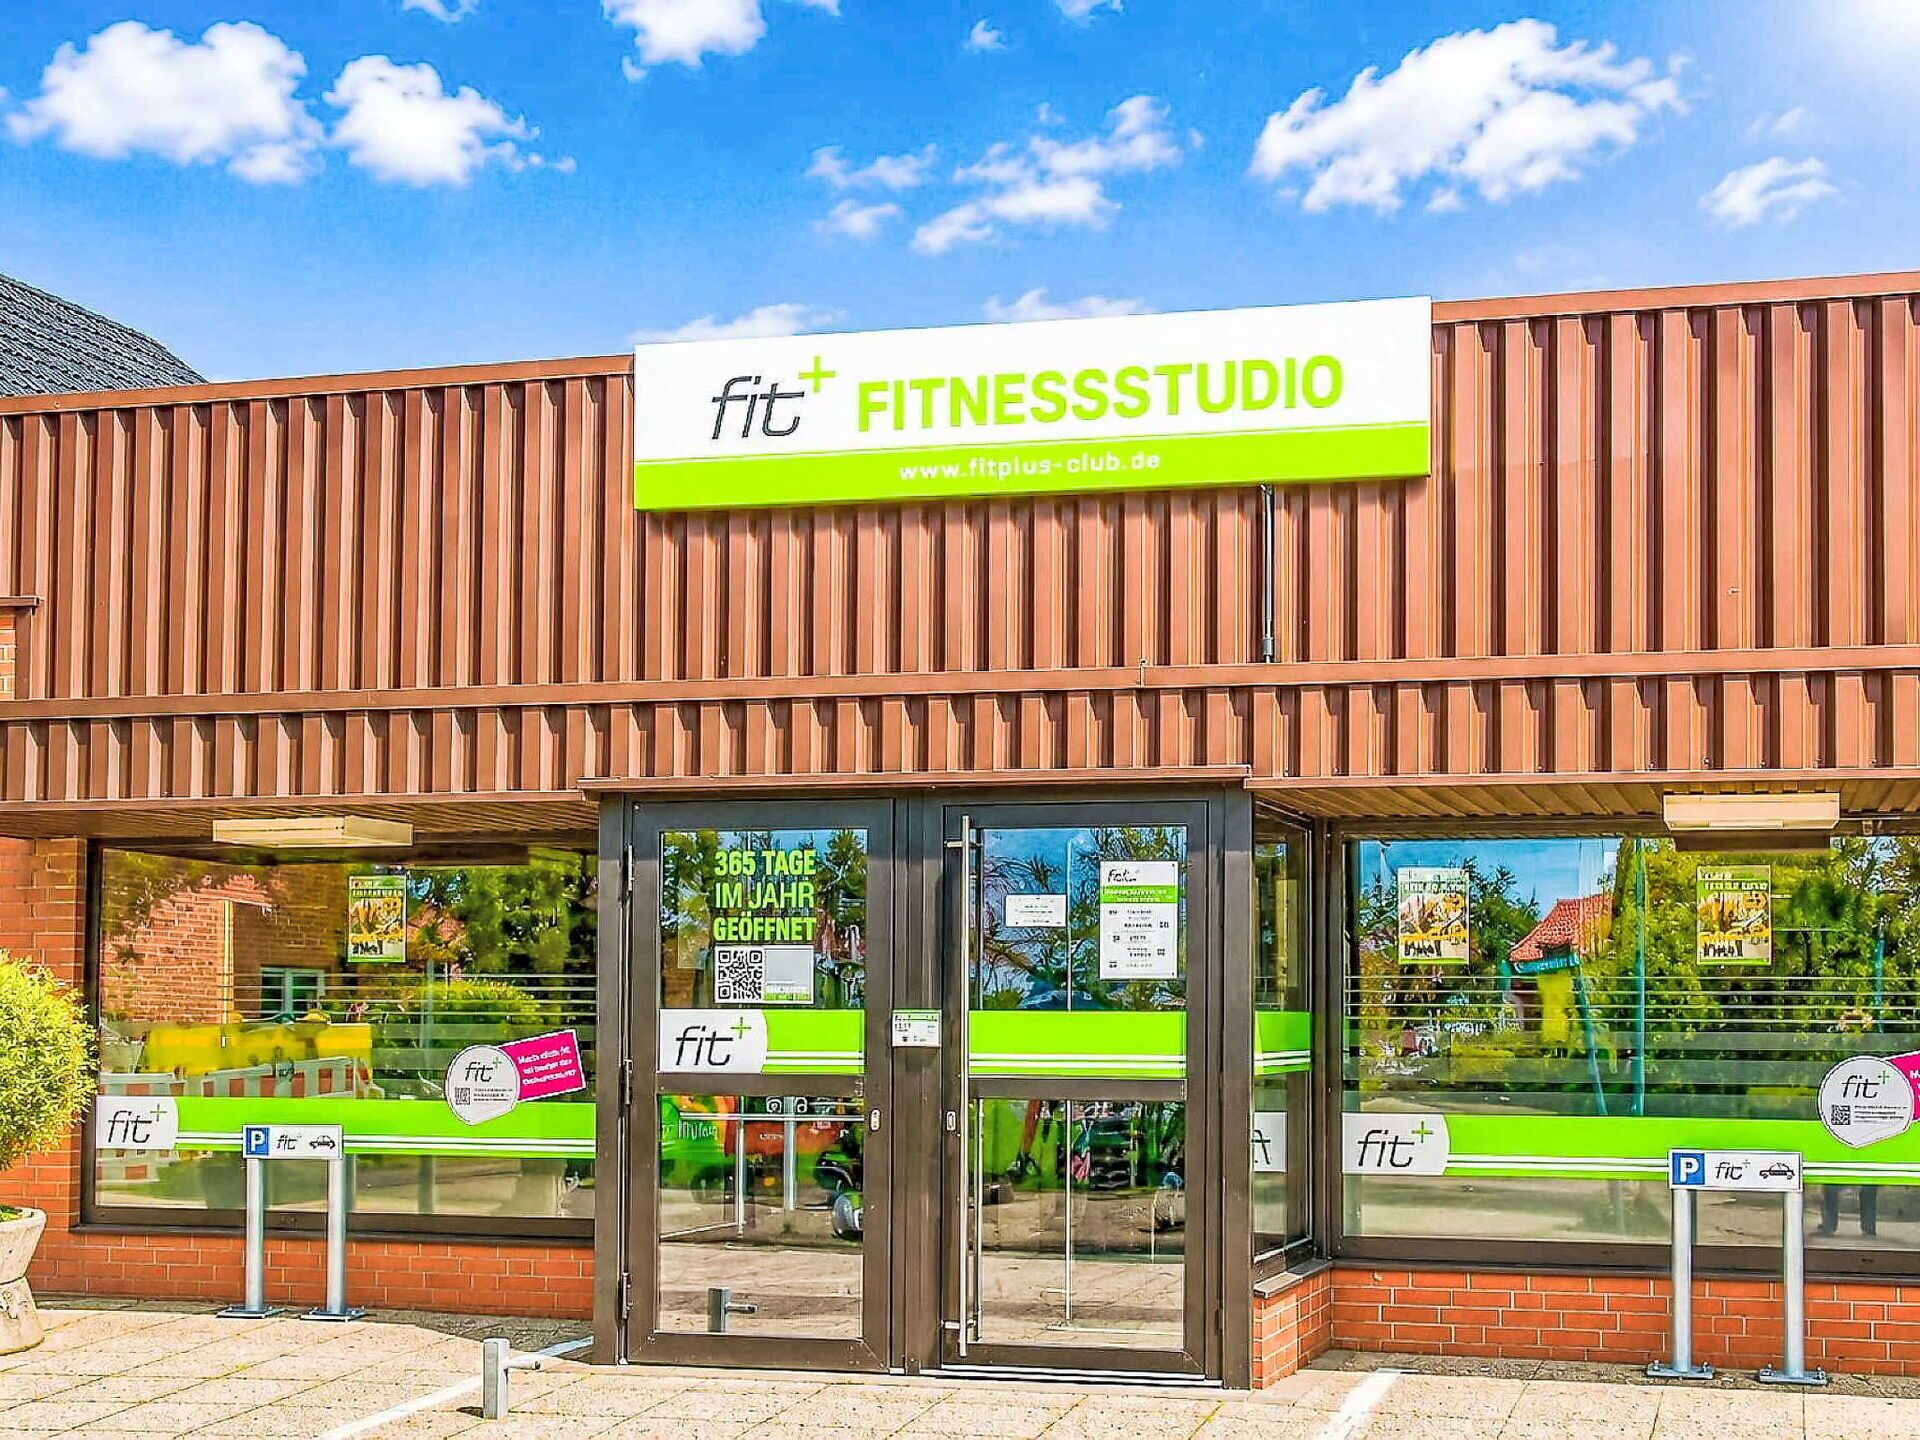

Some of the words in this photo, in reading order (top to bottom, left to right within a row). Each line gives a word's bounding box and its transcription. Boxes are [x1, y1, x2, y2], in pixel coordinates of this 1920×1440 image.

[858, 355, 1343, 432] FITNESSSTUDIO
[898, 451, 1161, 481] www.fitplus-club.de
[714, 849, 756, 877] 365
[761, 848, 817, 877] TAGE
[715, 881, 743, 909] IM
[748, 881, 815, 909] JAHR
[713, 910, 817, 941] GEÖFFNET
[1679, 1156, 1700, 1183] P
